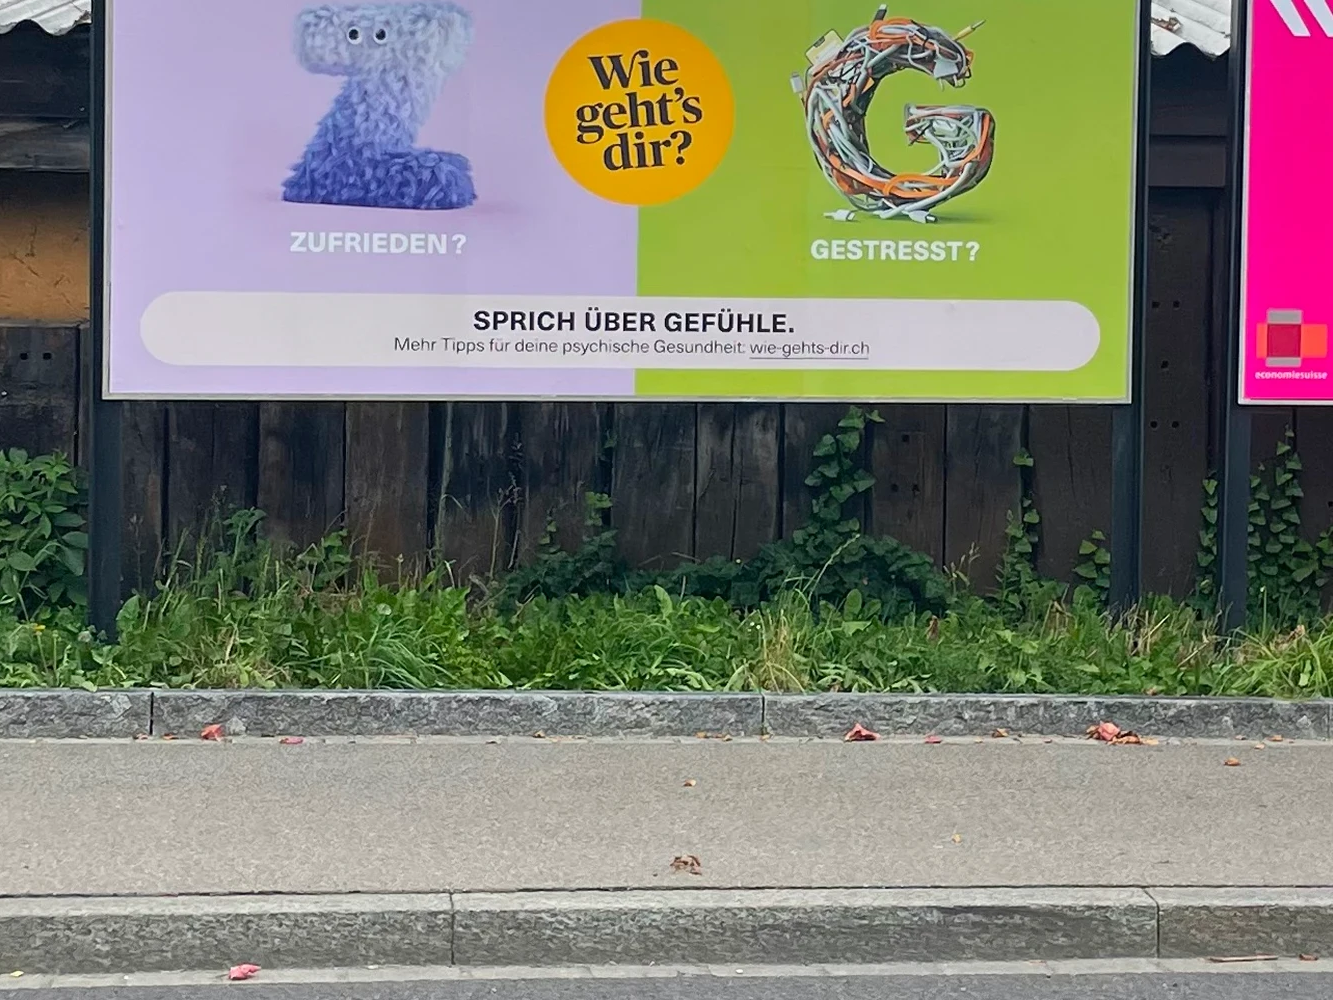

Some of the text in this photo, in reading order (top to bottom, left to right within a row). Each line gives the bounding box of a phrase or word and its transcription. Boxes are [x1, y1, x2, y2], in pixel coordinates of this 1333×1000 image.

[587, 49, 679, 90] Wie
[576, 87, 703, 144] geht’s
[603, 130, 692, 171] dir?
[473, 306, 795, 333] SPRICH ÜBER GEFÜHLE.
[394, 337, 870, 358] Mehr Tipps für deine psychische Gesundheit: wie-gehts-dir.ch
[1254, 370, 1329, 380] economiesuisse
